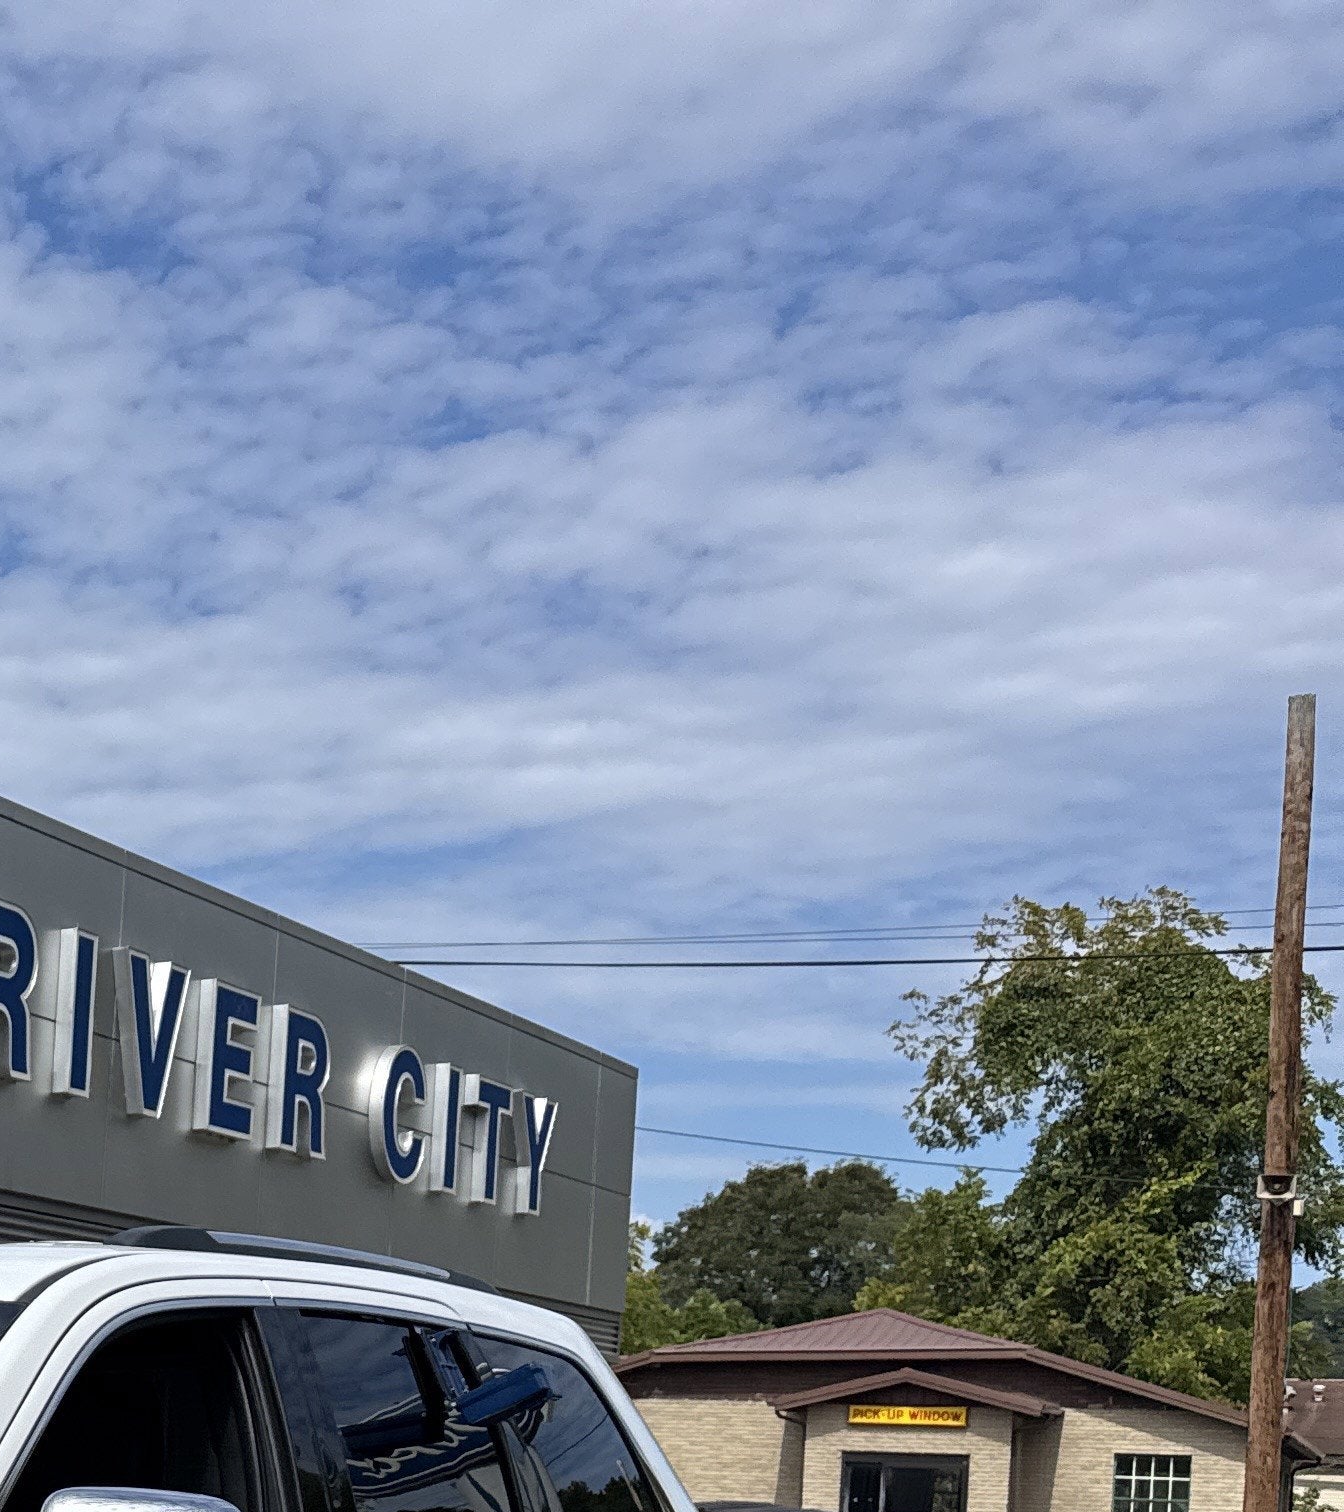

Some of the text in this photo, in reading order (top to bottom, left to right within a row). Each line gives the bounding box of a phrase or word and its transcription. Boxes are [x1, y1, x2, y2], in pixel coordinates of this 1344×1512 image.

[369, 1044, 558, 1215] CITY
[852, 1407, 964, 1421] PICK-UP WINDOW
